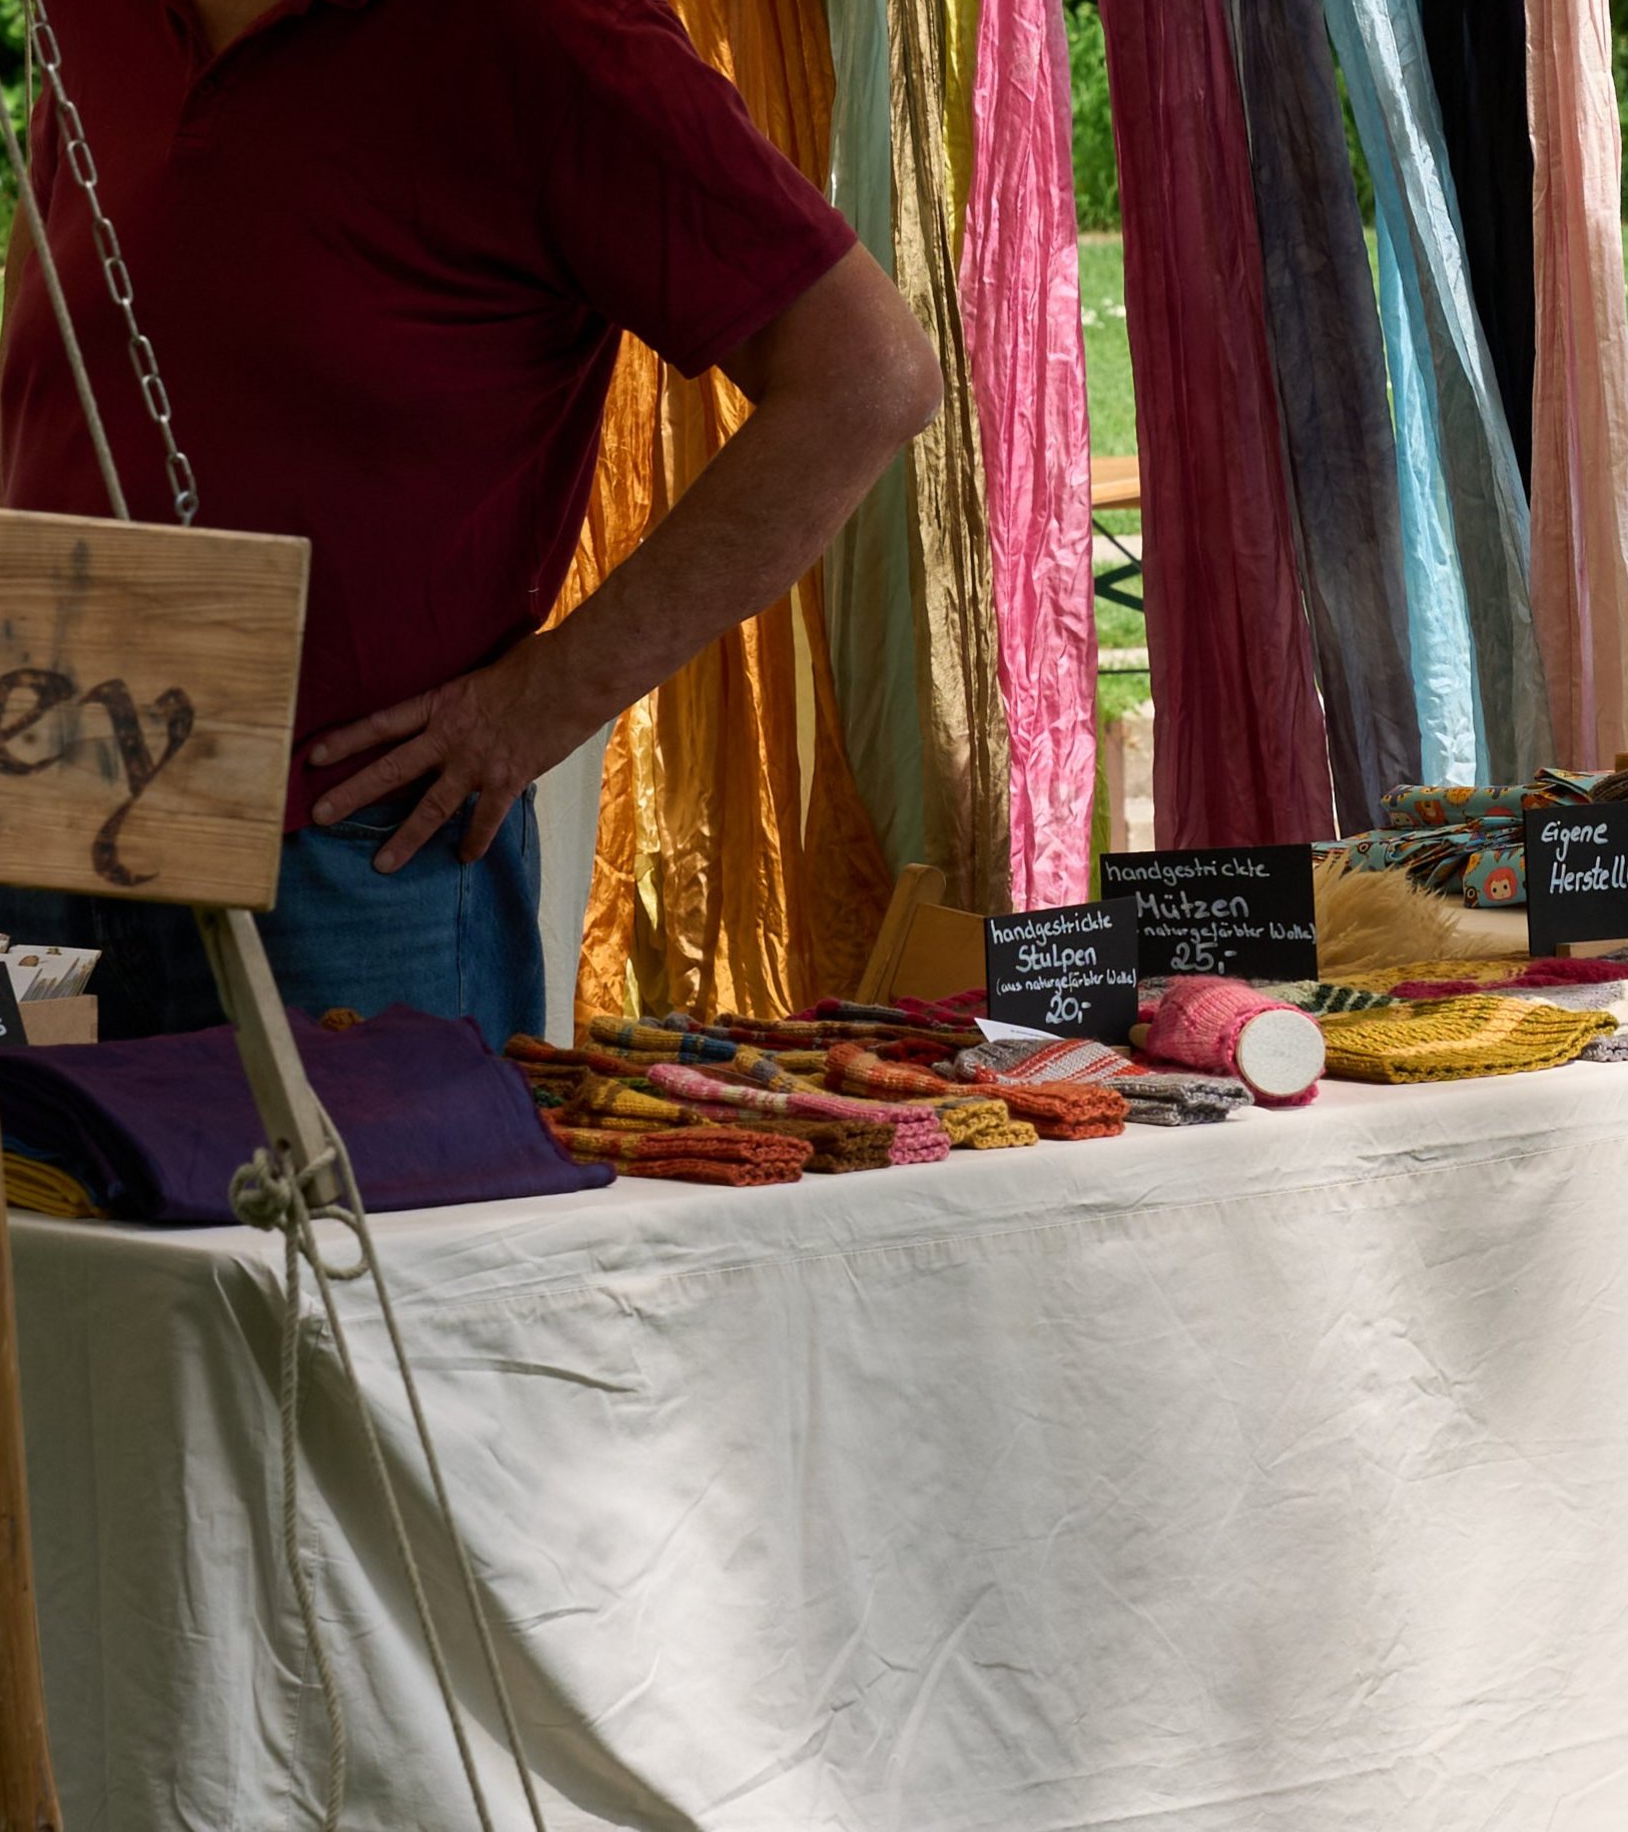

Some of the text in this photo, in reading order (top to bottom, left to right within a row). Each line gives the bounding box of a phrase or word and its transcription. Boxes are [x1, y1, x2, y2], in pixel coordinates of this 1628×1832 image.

[1540, 820, 1609, 862] Eigene
[1107, 858, 1271, 886] handgestrickte
[1135, 891, 1250, 920] Mützen
[990, 911, 1113, 947] handgestrickte
[996, 977, 1023, 996] (aus
